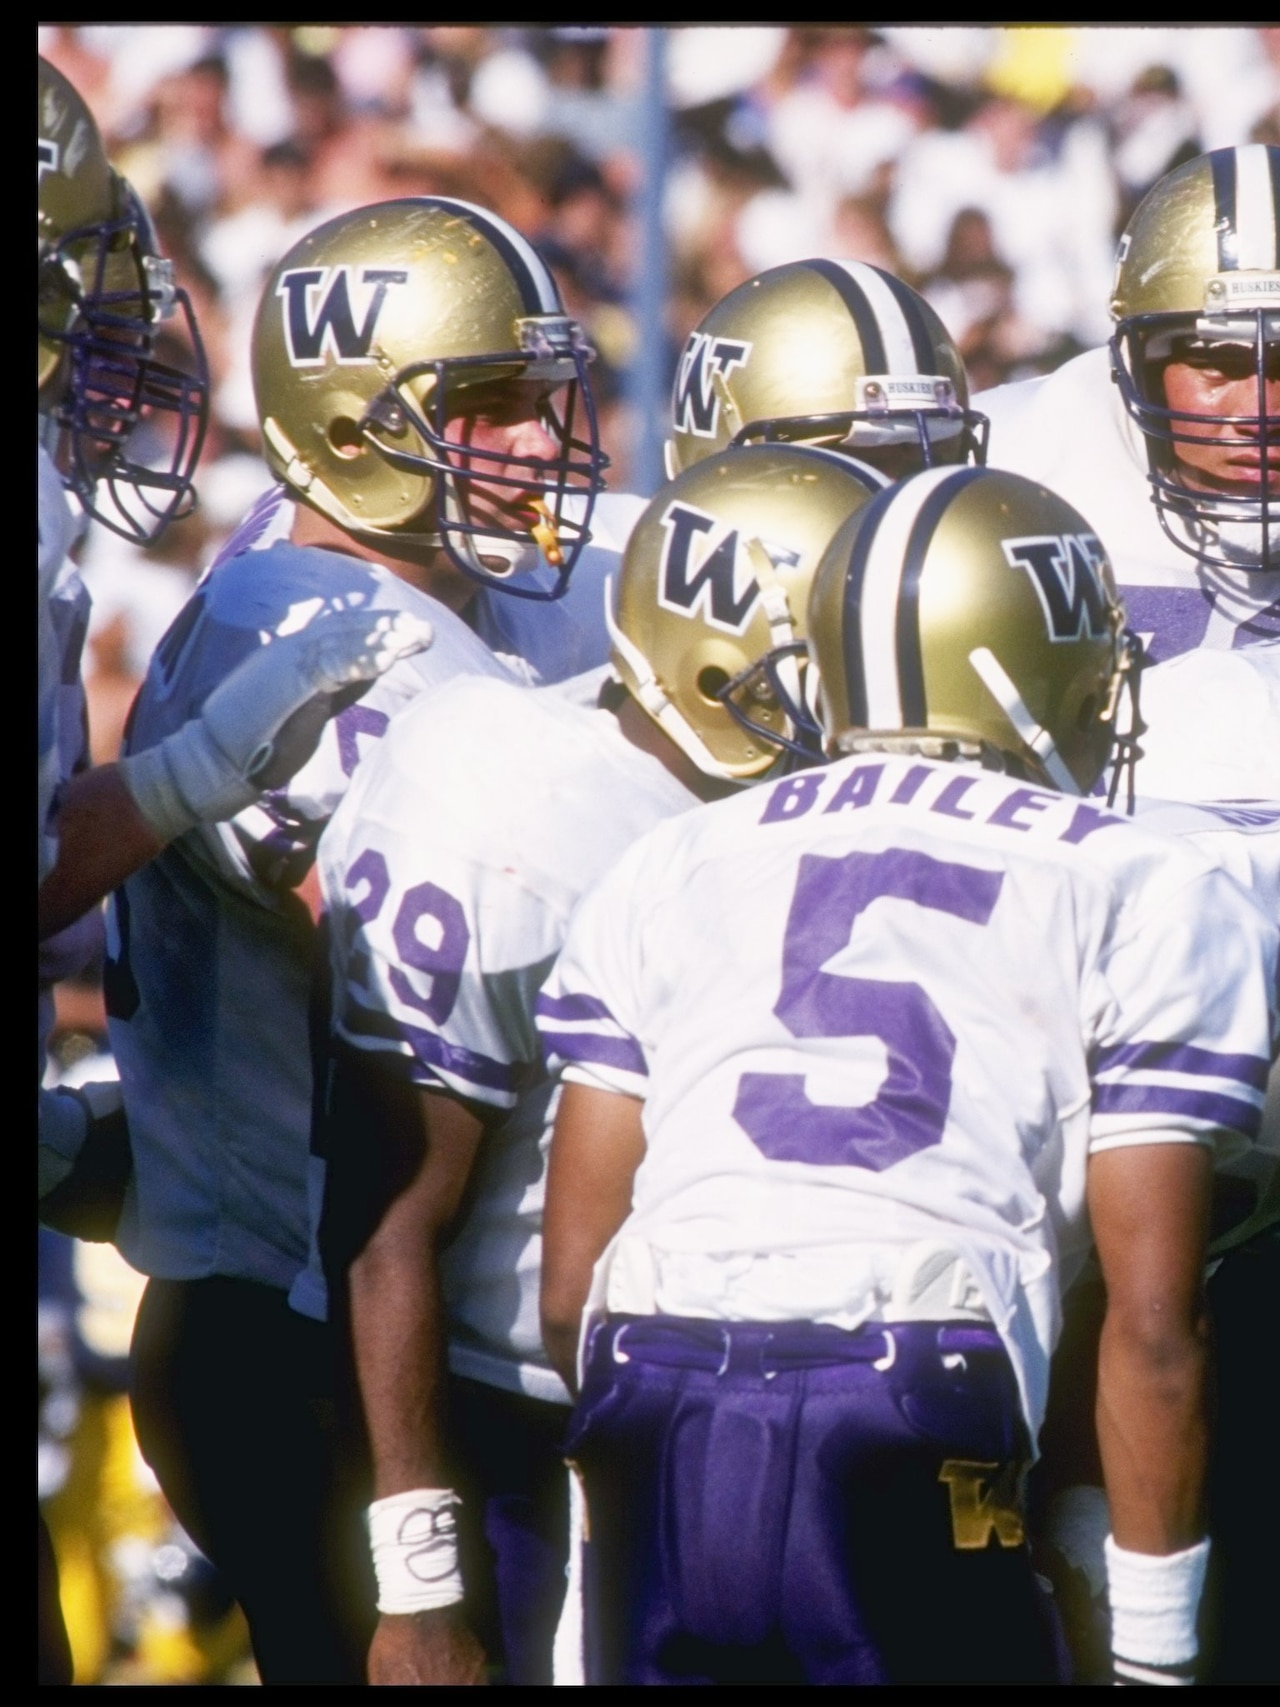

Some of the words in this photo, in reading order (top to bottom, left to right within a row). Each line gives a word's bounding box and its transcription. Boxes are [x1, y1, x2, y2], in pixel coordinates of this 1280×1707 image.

[275, 265, 410, 367] W
[673, 330, 753, 439] W
[887, 381, 932, 395] HUSKIES
[657, 500, 803, 637] W
[1001, 533, 1110, 642] W
[758, 763, 1131, 845] BAILEY
[344, 848, 471, 1027] 29
[732, 847, 1005, 1172] 5
